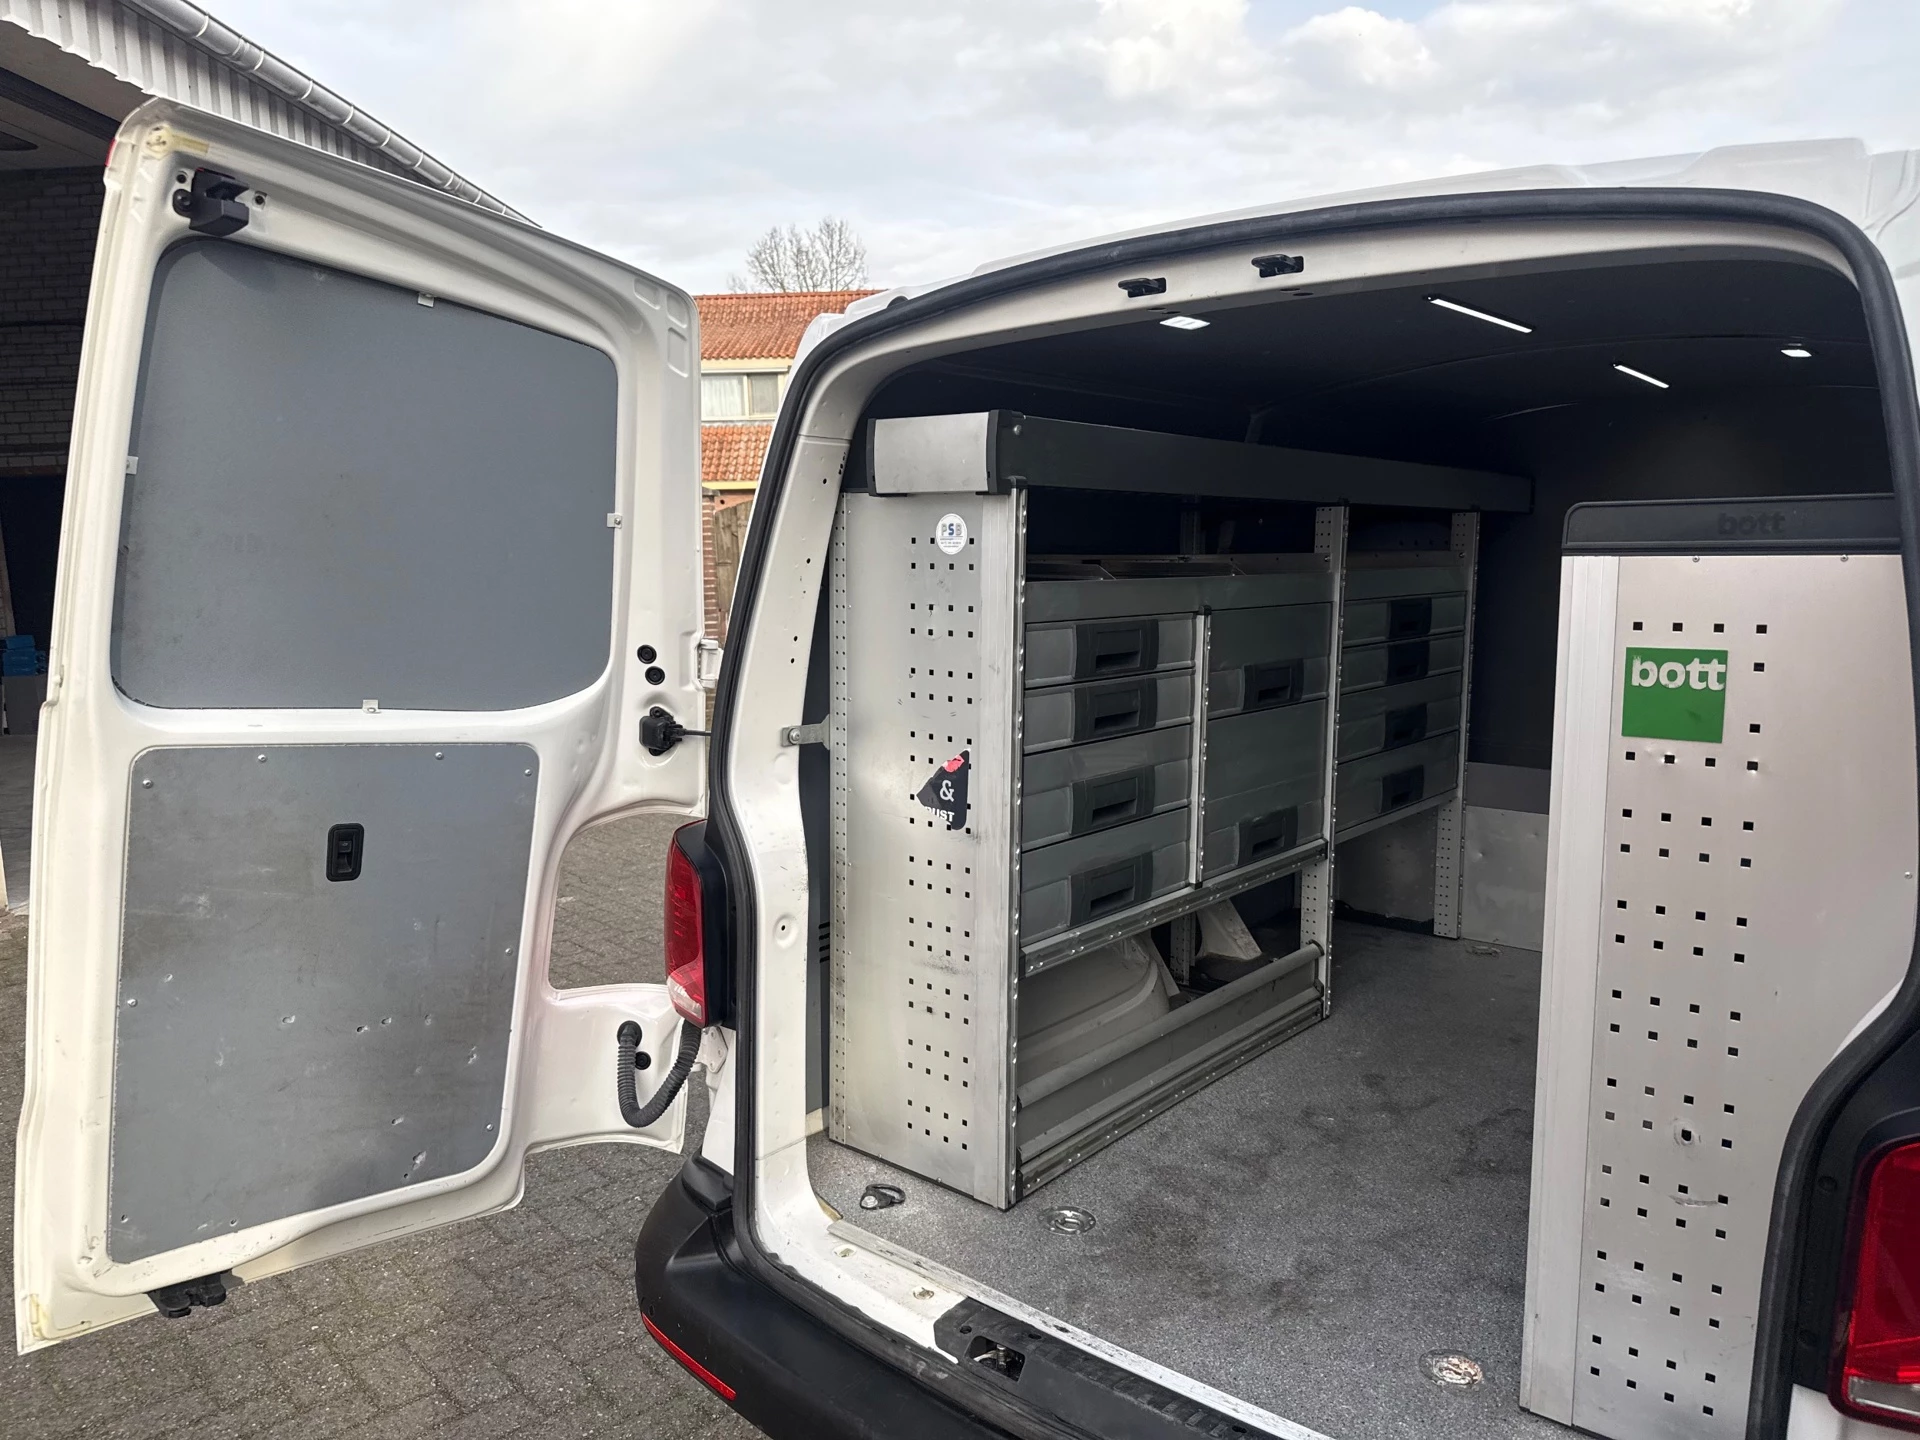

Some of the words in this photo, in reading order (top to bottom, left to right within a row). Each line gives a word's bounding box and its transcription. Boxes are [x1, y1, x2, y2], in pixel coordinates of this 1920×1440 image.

[941, 523, 962, 536] PSB
[1717, 511, 1785, 535] bott
[1631, 656, 1726, 691] bott
[940, 780, 954, 802] &
